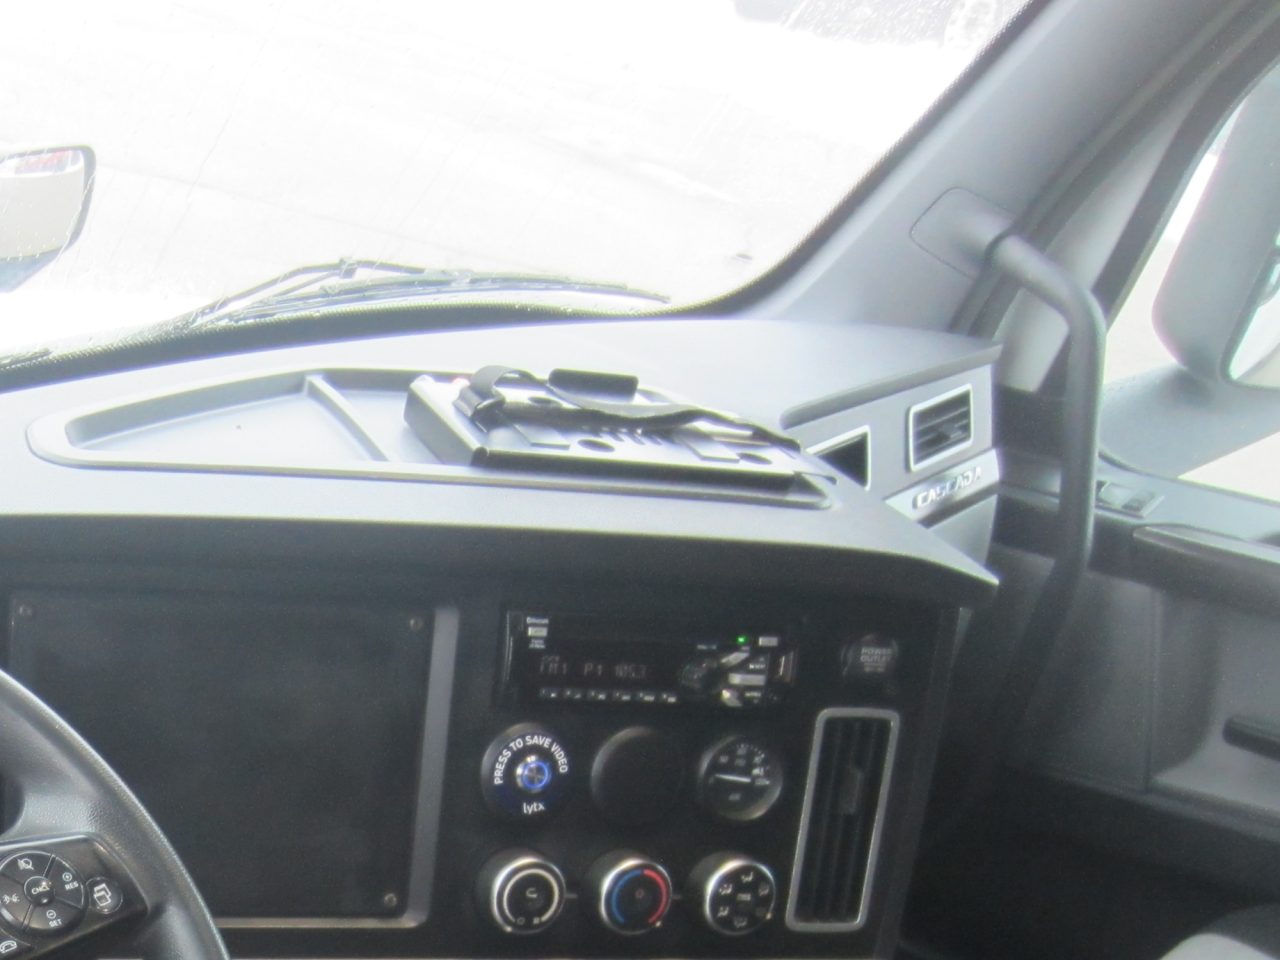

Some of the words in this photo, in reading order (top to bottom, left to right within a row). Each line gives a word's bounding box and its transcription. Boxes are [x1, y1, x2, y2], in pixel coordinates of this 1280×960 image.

[493, 749, 512, 785] PRESS
[509, 738, 524, 751] TO
[525, 735, 552, 748] SAVE
[551, 742, 568, 773] VIDEO
[523, 802, 545, 814] lytx
[65, 880, 79, 890] RES
[49, 918, 62, 927] SET
